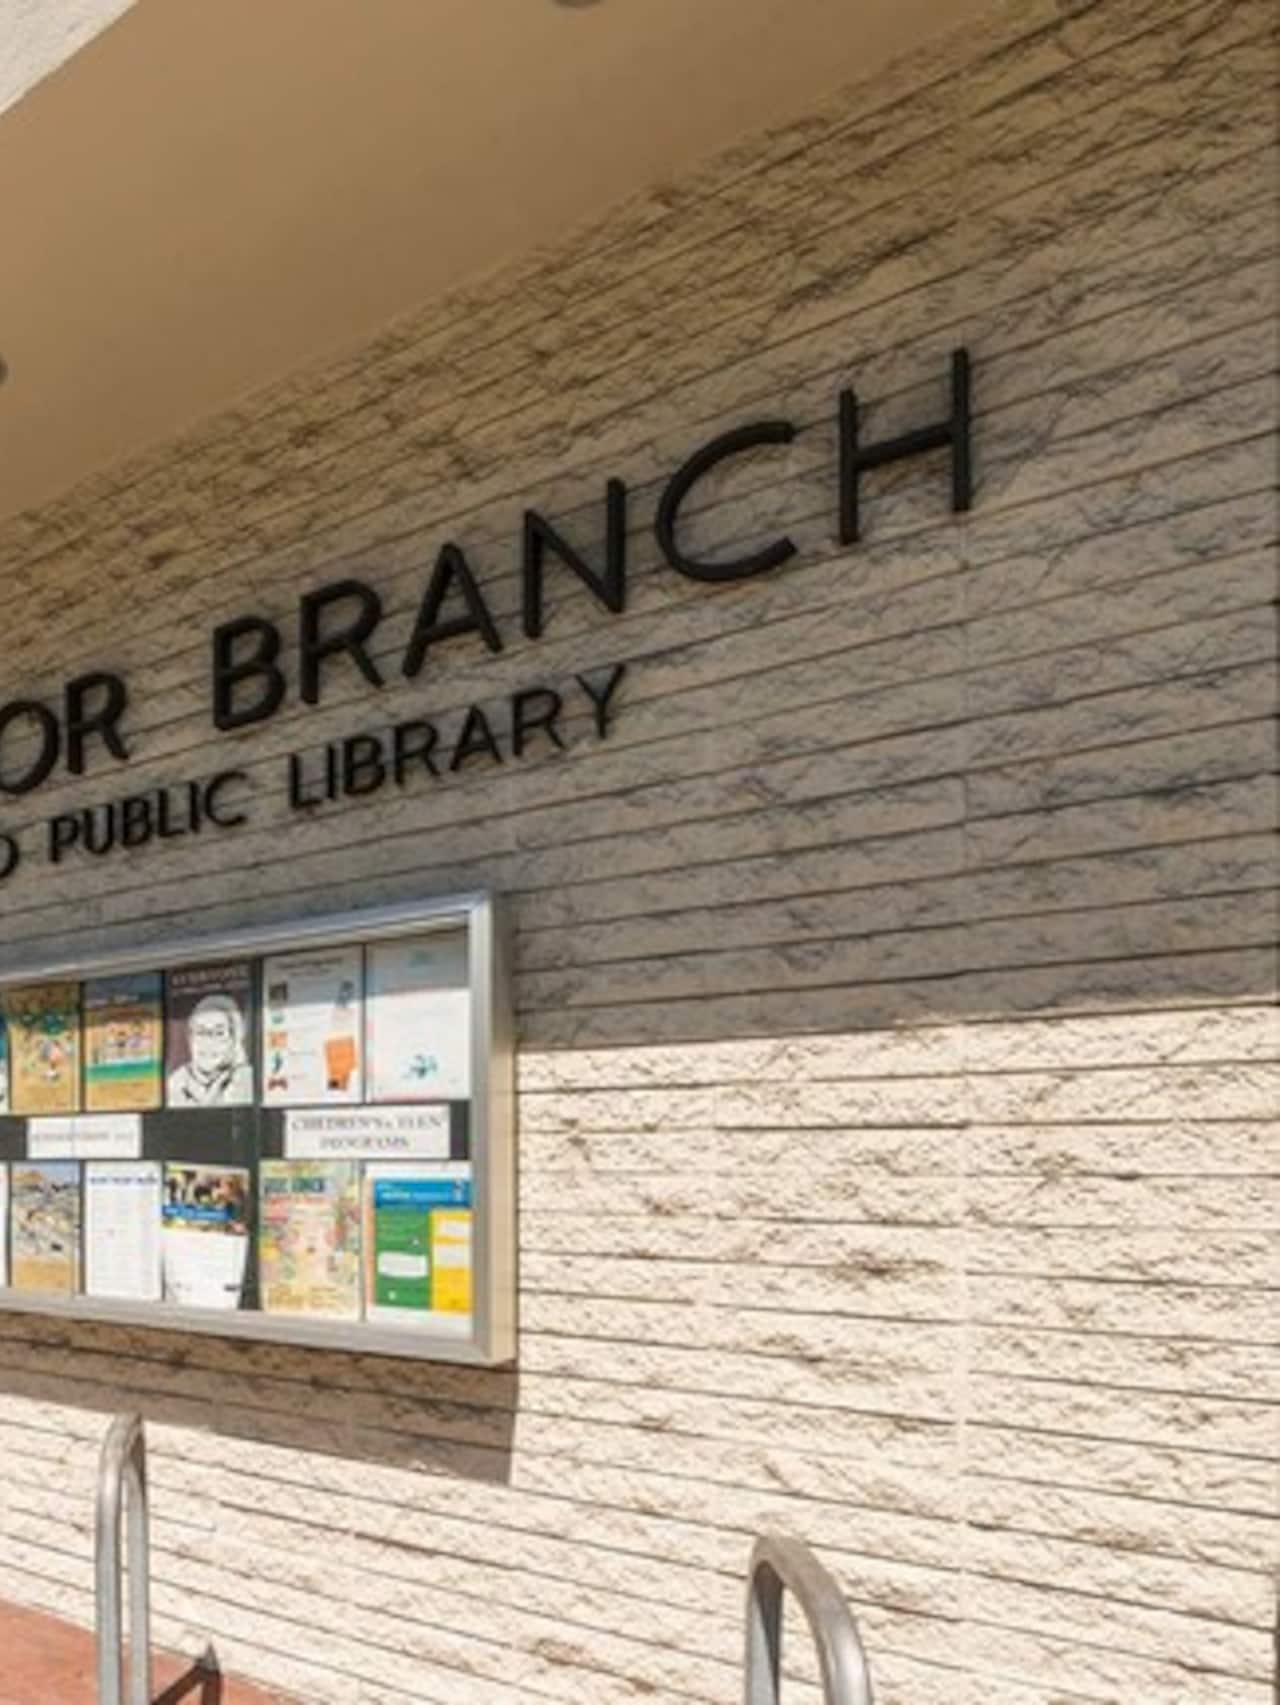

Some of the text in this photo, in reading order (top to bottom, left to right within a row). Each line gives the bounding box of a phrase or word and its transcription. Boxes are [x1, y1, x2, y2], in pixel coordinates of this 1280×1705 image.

[213, 346, 972, 732] BRANCH
[49, 770, 248, 863] PUBLIC
[289, 662, 627, 811] LIBRARY
[321, 1134, 410, 1150] PROGRAMS
